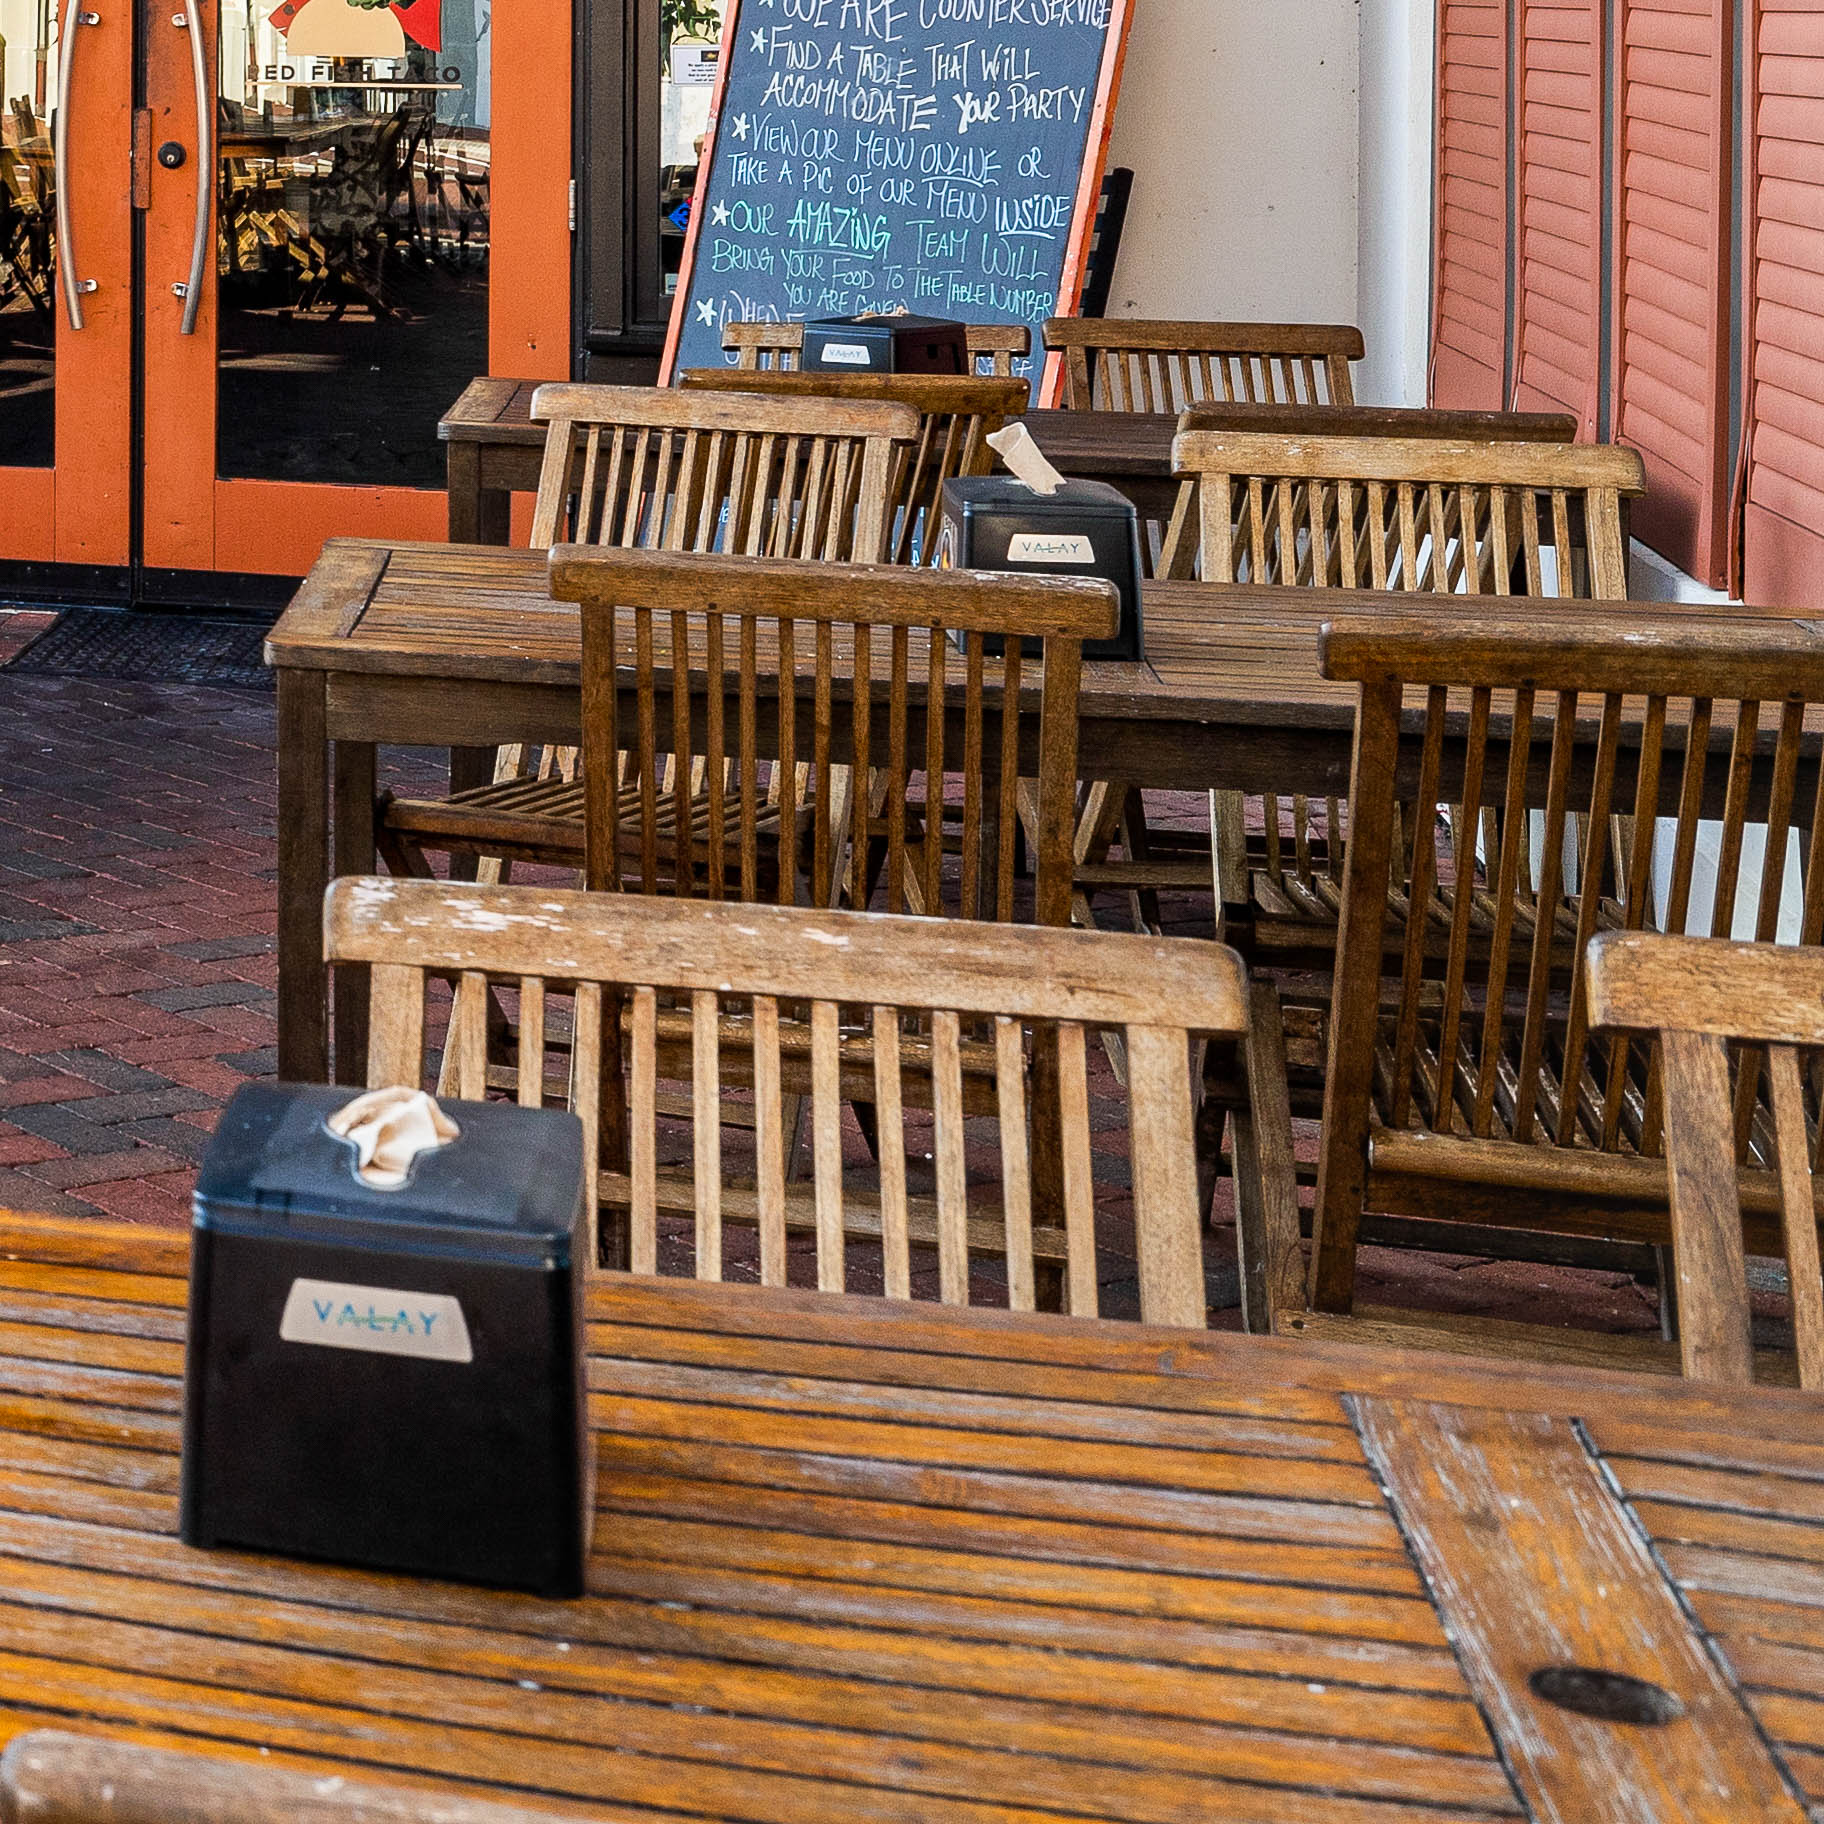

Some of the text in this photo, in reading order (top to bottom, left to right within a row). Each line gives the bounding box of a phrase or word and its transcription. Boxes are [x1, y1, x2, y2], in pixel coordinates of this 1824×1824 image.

[312, 65, 372, 82] FISH
[387, 66, 461, 83] TACO
[768, 24, 822, 70] FIND
[826, 42, 845, 74] A
[850, 45, 917, 89] TABLE
[924, 40, 976, 88] THAT
[760, 72, 938, 132] ACCOMMODATE
[952, 91, 1001, 135] YOUR
[1006, 83, 1086, 124] PARTY
[752, 113, 1051, 186] VIEW OUR MENU ONLINE OR
[728, 151, 768, 187] TAKE
[778, 159, 793, 185] A
[846, 171, 873, 205] OF
[879, 178, 917, 206] OUR
[926, 180, 988, 224] MENU
[730, 200, 779, 236] OUR
[905, 219, 968, 265] TEAM
[981, 233, 1049, 280] WILL
[712, 238, 1053, 323] BRING YOUR FOOD TO THE TABLE NUMBER
[783, 282, 811, 307] YOU
[816, 288, 850, 314] ARE
[1022, 542, 1081, 555] VALAY
[312, 1298, 440, 1337] VALAY
